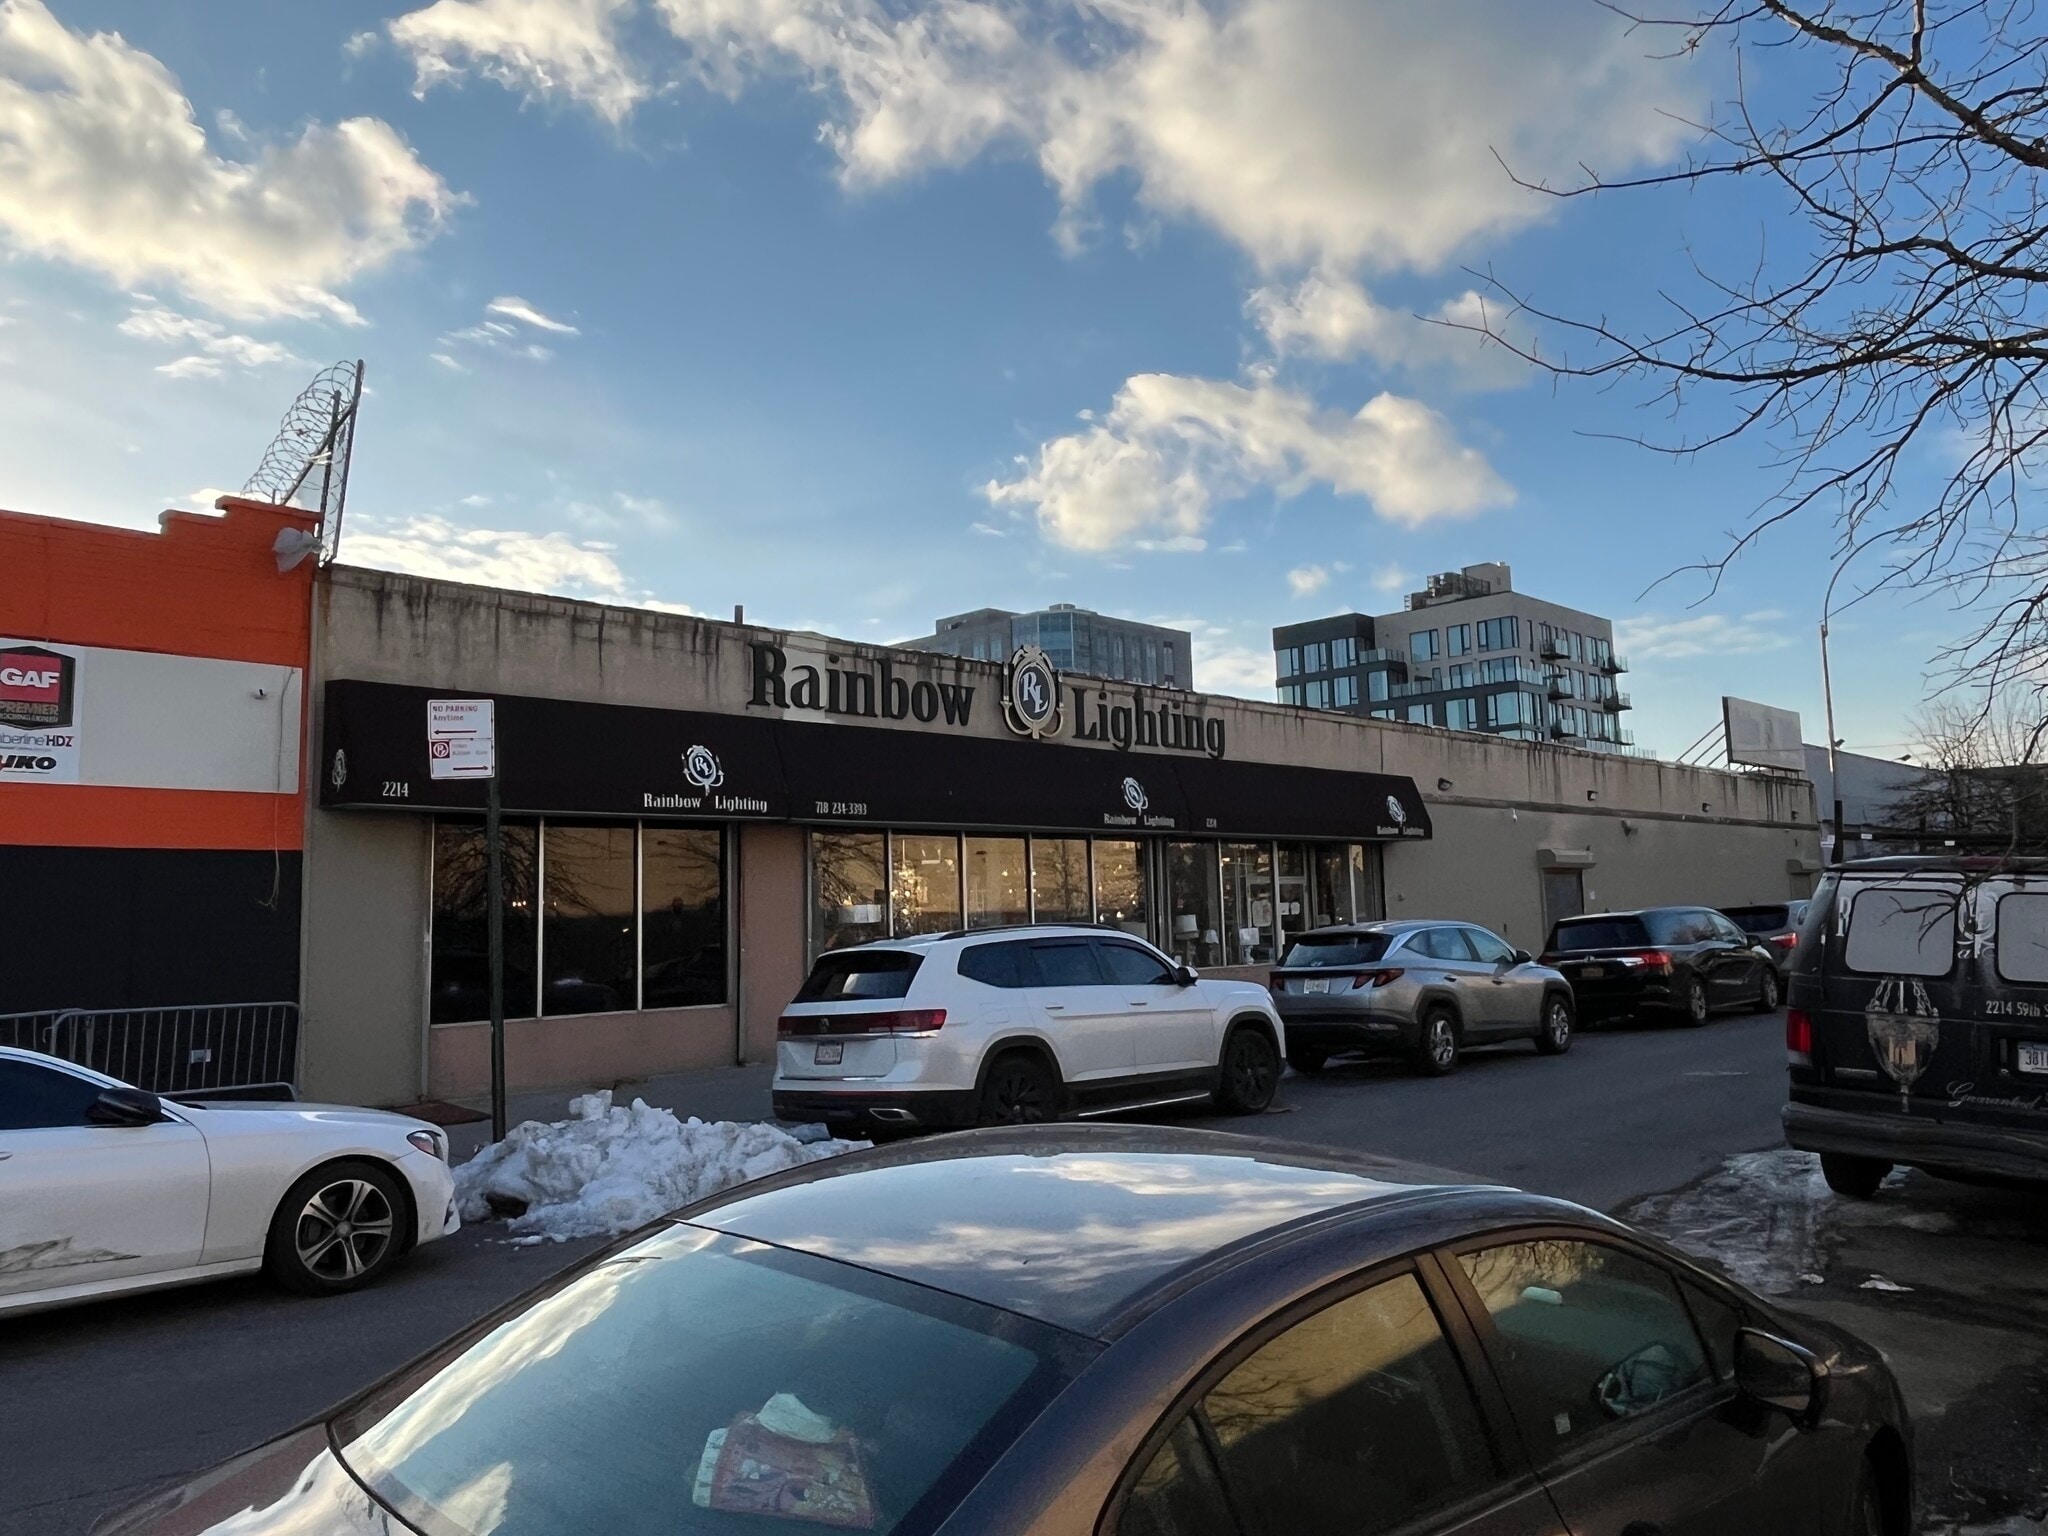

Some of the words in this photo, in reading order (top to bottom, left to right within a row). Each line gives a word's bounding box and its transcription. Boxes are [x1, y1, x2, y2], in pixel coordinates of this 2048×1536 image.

[0, 668, 60, 688] GAF
[746, 641, 976, 726] Rainbow
[1072, 687, 1226, 759] Lighting
[46, 734, 75, 748] HDZ
[382, 781, 409, 797] 2214
[643, 793, 702, 808] Rainbow
[715, 795, 767, 813] Lighting
[815, 801, 829, 814] 718
[832, 802, 867, 815] 234-3393
[1985, 1000, 2013, 1014] 2214
[2016, 1002, 2040, 1016] 59th
